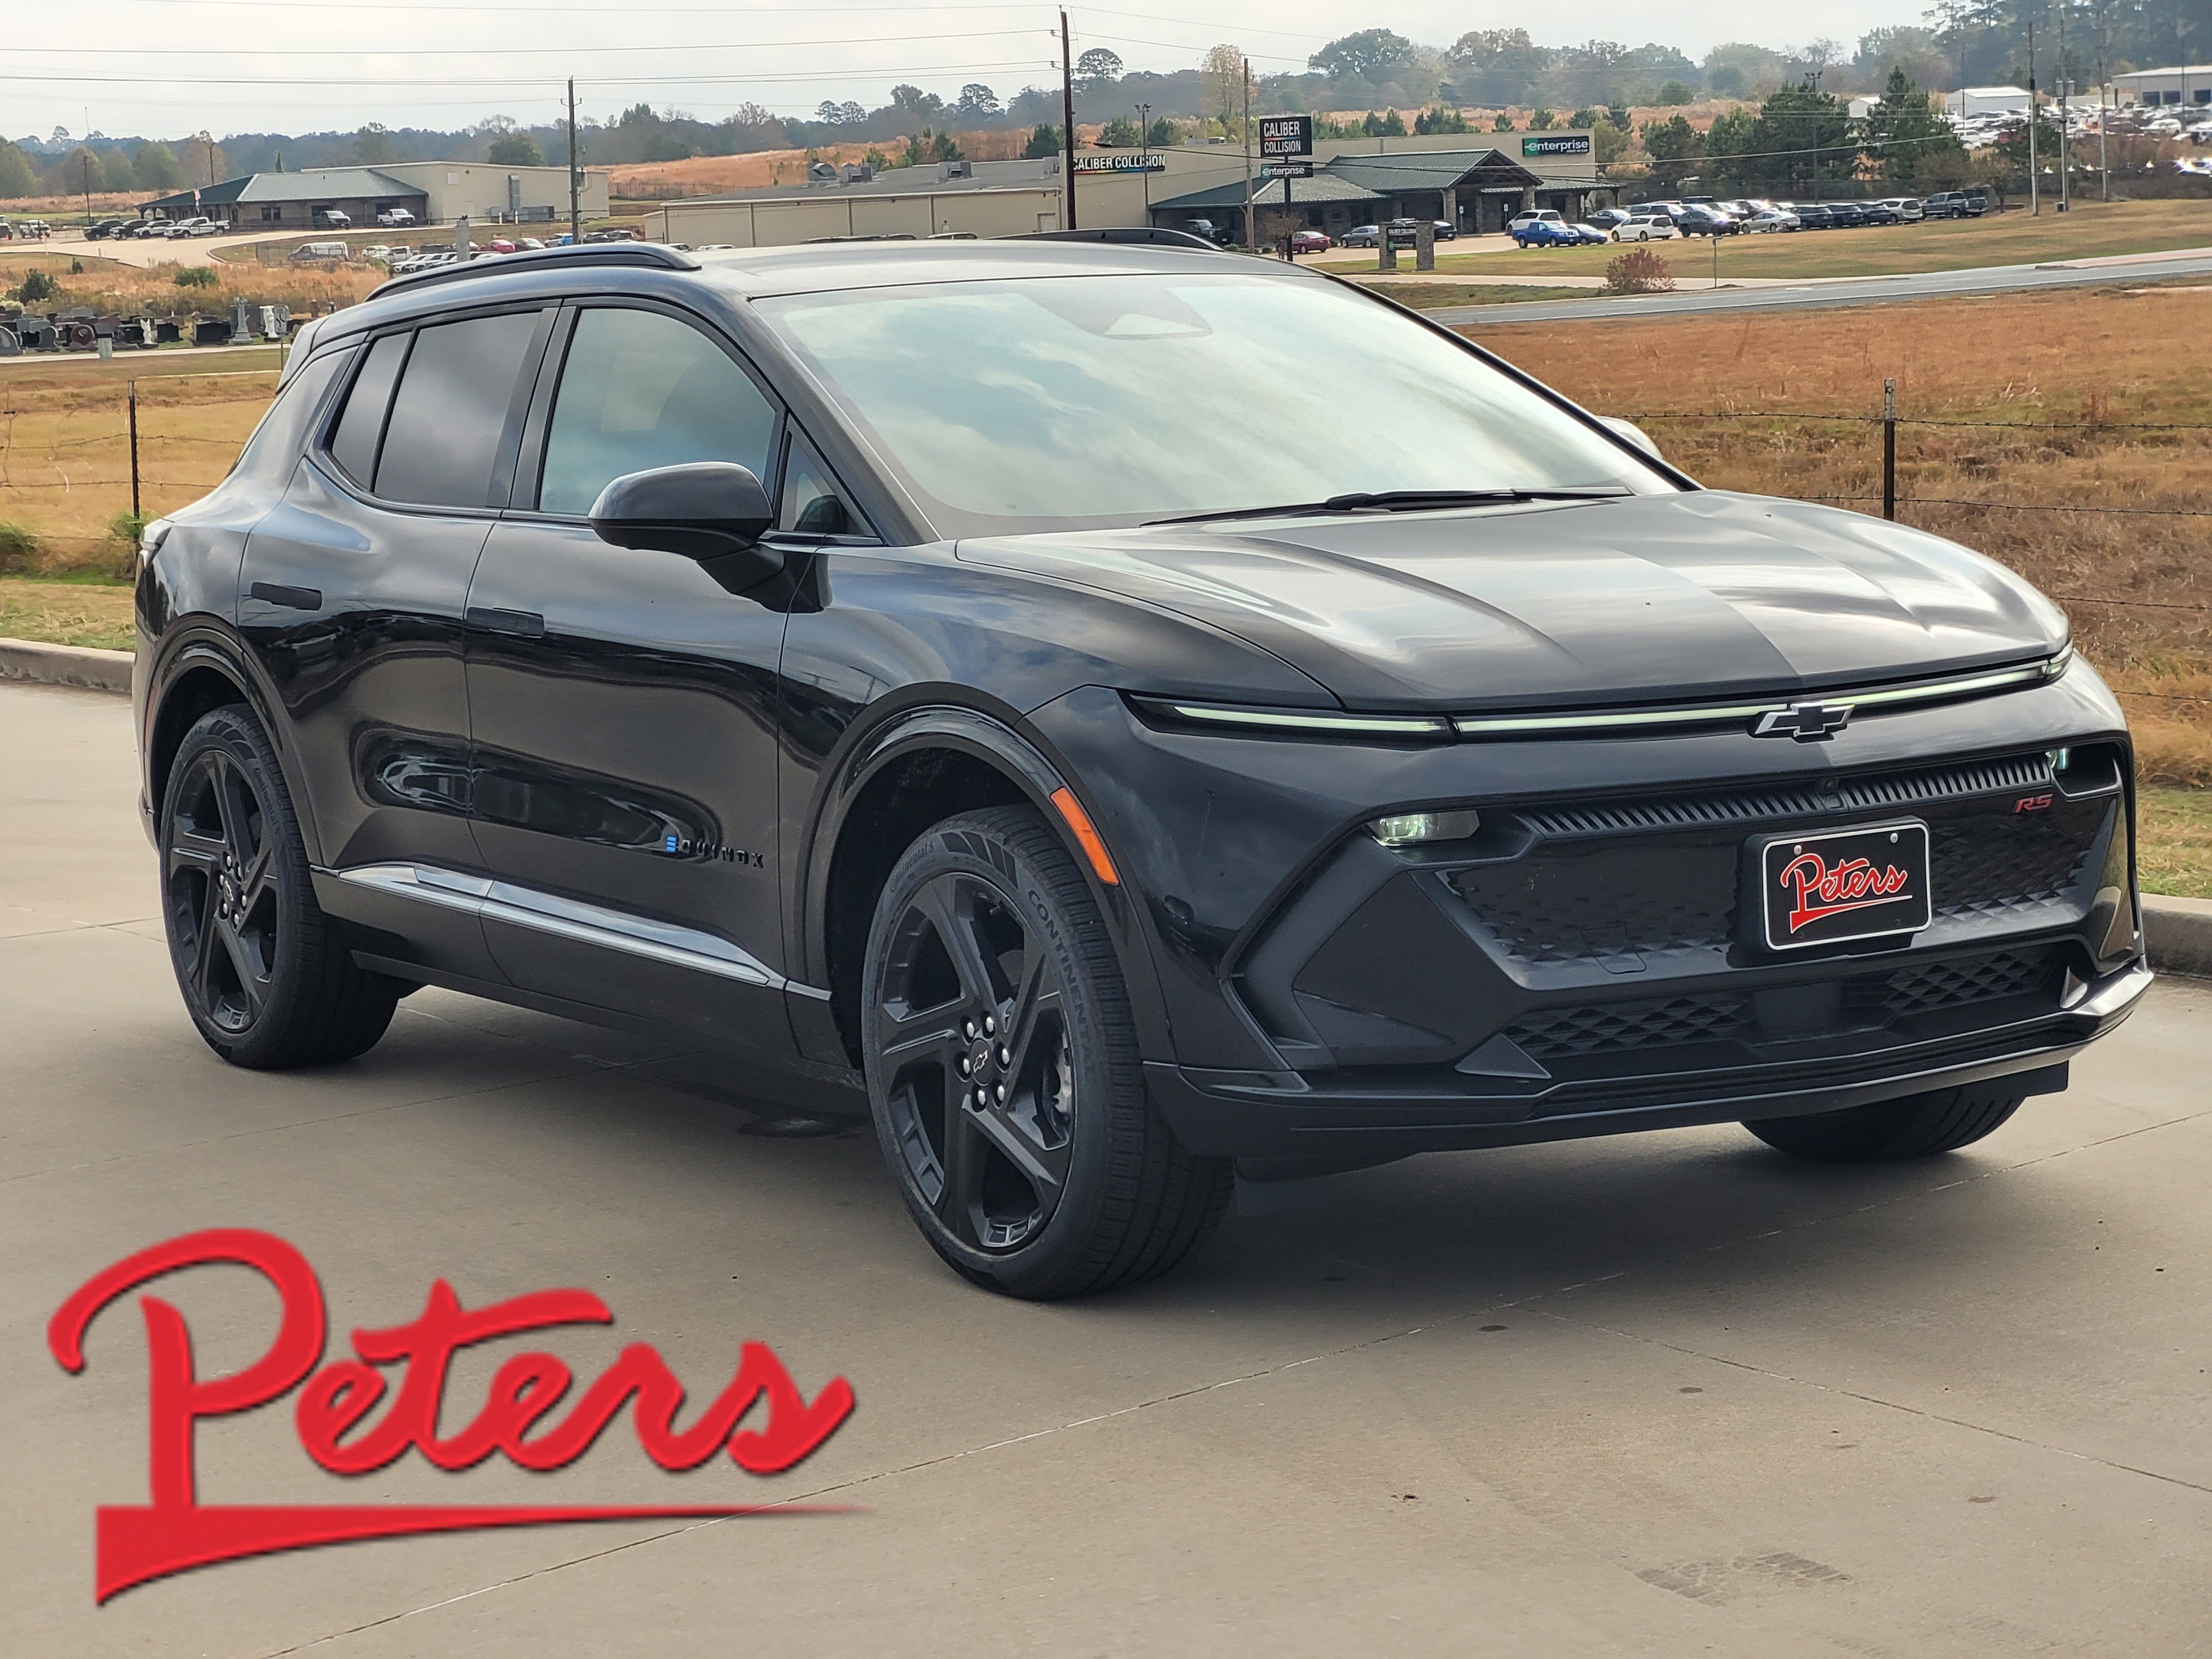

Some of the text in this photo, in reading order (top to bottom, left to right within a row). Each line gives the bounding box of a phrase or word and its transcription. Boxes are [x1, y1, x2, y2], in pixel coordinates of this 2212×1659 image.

[1263, 121, 1300, 137] CALIBER
[1264, 140, 1301, 153] COLLISION
[1525, 139, 1588, 152] enterprise
[1073, 155, 1165, 170] CALIBER COLLISION
[1262, 167, 1305, 177] enterprise
[2015, 793, 2053, 812] RS
[1780, 852, 1909, 917] Peters
